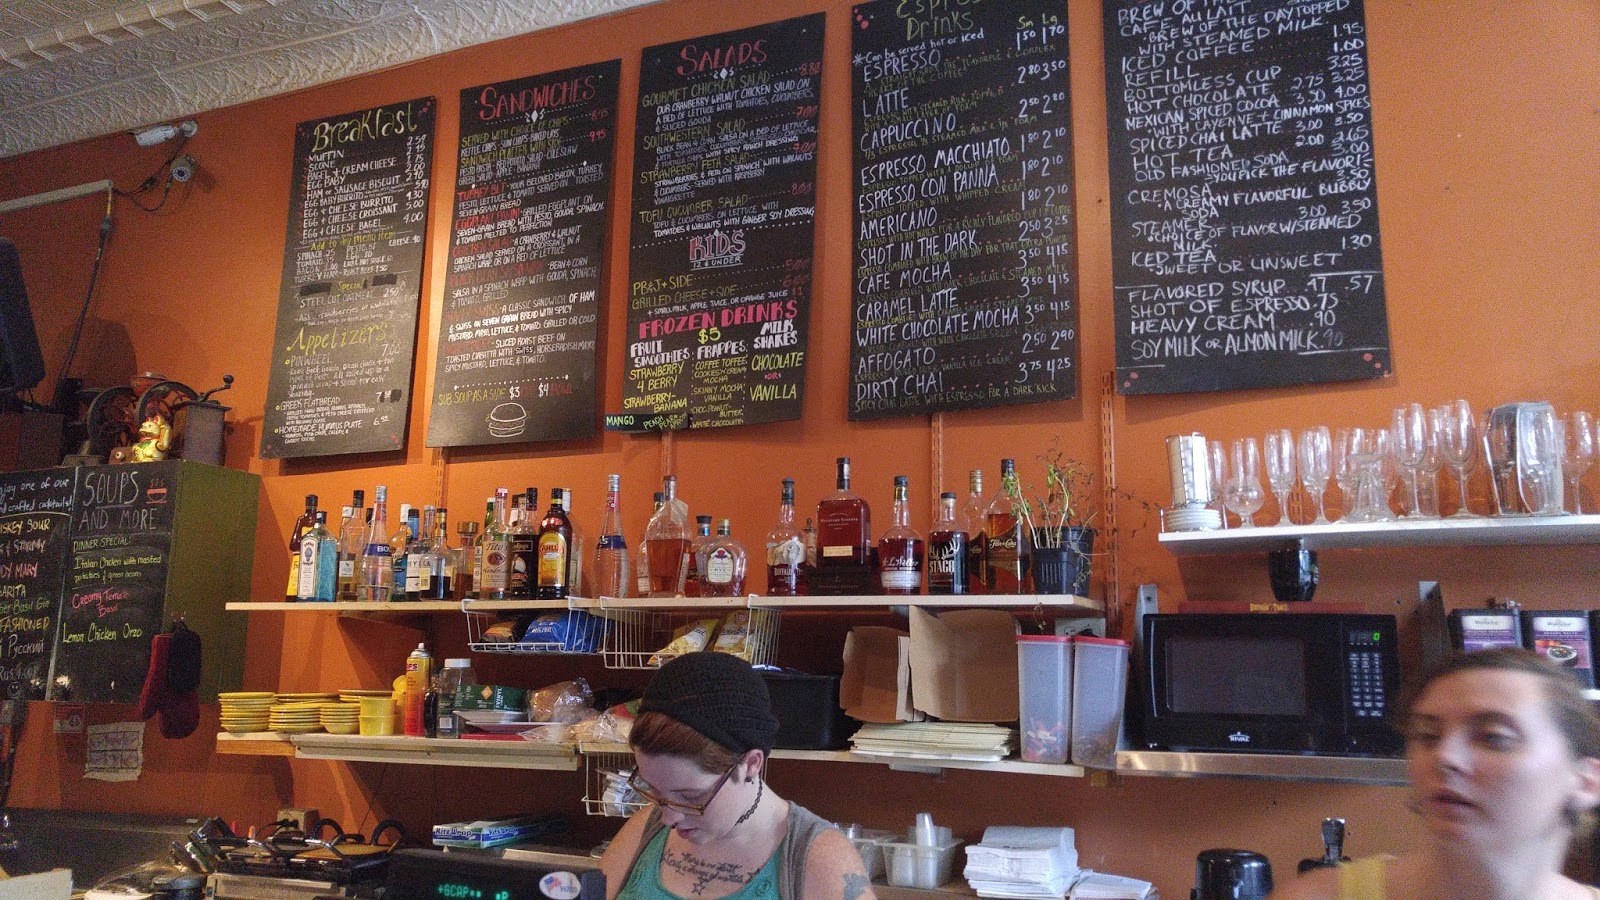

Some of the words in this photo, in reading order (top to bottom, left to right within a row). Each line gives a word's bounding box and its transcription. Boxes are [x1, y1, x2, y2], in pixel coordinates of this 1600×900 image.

[1118, 0, 1164, 25] BREW
[1121, 19, 1172, 36] CAFE
[1182, 11, 1201, 24] AU
[1206, 2, 1246, 20] LAIT
[907, 11, 974, 41] Drinks
[1149, 25, 1194, 43] BREW
[1200, 18, 1219, 32] OF
[1223, 11, 1257, 26] THE
[899, 41, 926, 55] served
[961, 27, 984, 42] iced
[1139, 39, 1175, 55] WITH
[1183, 27, 1269, 47] STEAMED
[676, 39, 768, 76] SALADS
[864, 49, 941, 83] ESPRESSO
[1122, 54, 1165, 73] ICED
[1176, 41, 1254, 62] COFFEE
[1124, 74, 1235, 102] BOTTOMLESS
[1246, 66, 1282, 82] CUP
[1125, 66, 1200, 87] REFILL
[480, 74, 596, 121] SANDWICHES
[642, 87, 688, 108] GOURMET
[691, 77, 736, 96] CHICKEN
[740, 71, 770, 86] SALAD
[1128, 98, 1167, 114] HOT
[1173, 84, 1271, 107] CHOCOLATE
[862, 88, 909, 119] LATTE
[1126, 110, 1184, 131] MEXICAN
[1189, 103, 1232, 119] SPICED
[1237, 98, 1279, 111] COCOA
[1274, 102, 1334, 120] CINNAMON
[312, 102, 418, 152] Breakfast
[716, 118, 746, 134] SALAD
[860, 112, 957, 152] CAPPUCCINO
[1129, 133, 1187, 155] SPICED
[1190, 126, 1226, 145] CHAI
[1233, 123, 1281, 140] LATTE
[308, 150, 344, 163] MUFFIN
[309, 161, 335, 172] SCONE
[702, 156, 721, 171] FETA
[725, 152, 750, 165] SALAD
[861, 155, 927, 187] ESPRESSO
[934, 137, 1010, 169] MACCHIATO
[1133, 153, 1179, 172] HOT
[1189, 145, 1233, 163] TEA
[1135, 169, 1165, 183] OLD
[1253, 150, 1289, 168] SODA
[307, 172, 330, 180] BAGEL
[342, 162, 369, 175] CREAM
[370, 157, 397, 170] CHEESE
[1274, 163, 1299, 177] THE
[306, 190, 323, 200] HAM
[334, 182, 366, 194] SAUSAGE
[369, 175, 400, 189] BISCUIT
[859, 183, 915, 214] ESPRESSO
[921, 176, 947, 198] CON
[953, 164, 999, 193] PANNA
[1128, 184, 1213, 205] CREMOSA
[1176, 193, 1229, 210] CREAMY
[1234, 187, 1312, 205] FLAVORFUL
[1319, 178, 1371, 196] BUBBLY
[303, 218, 318, 229] EGG
[358, 203, 399, 219] CROISSANT
[639, 208, 663, 224] TOFU
[718, 194, 748, 209] SALAD
[1182, 205, 1219, 221] SODA
[860, 206, 938, 241] AMERICANO
[1131, 218, 1213, 238] STEAMER
[1154, 228, 1203, 242] CHOICE
[1208, 226, 1226, 239] OF
[1232, 221, 1280, 237] FLAVOR
[689, 230, 746, 261] KIDS
[860, 244, 894, 269] SHOT
[900, 239, 914, 262] IN
[918, 235, 940, 256] THE
[944, 229, 978, 252] DARK
[711, 256, 742, 266] UNDER
[1131, 252, 1170, 267] ICED
[1173, 250, 1217, 263] TEA
[1156, 263, 1214, 275] SWEET
[1218, 259, 1245, 273] OR
[1251, 253, 1342, 271] UNSWEET
[669, 274, 694, 288] SIDE
[858, 273, 890, 295] CAFE
[900, 261, 953, 287] MOCHA
[569, 293, 578, 304] OF
[580, 291, 595, 302] HAM
[631, 293, 671, 310] GRILLED
[1128, 280, 1224, 303] FLAVORED
[1231, 279, 1286, 296] SYRUP
[482, 316, 500, 327] SEVEN
[555, 305, 572, 315] SPICY
[856, 295, 918, 323] CARAMEL
[921, 287, 959, 313] LATTE
[1130, 301, 1184, 319] SHOT
[1189, 300, 1222, 314] OF
[1231, 294, 1310, 313] ESPRESSO
[639, 311, 716, 340] FROZEN
[720, 299, 798, 328] DRINKS
[760, 319, 794, 335] MILK
[856, 324, 896, 347] WHITE
[902, 313, 969, 341] CHOCOLATE
[973, 305, 1019, 330] MOCHA
[1131, 315, 1197, 335] HEAVY
[1204, 312, 1275, 331] CREAM
[287, 323, 388, 356] Appetizers
[495, 338, 516, 349] SLICED
[538, 334, 555, 344] BEEF
[697, 327, 721, 344] $5
[753, 330, 798, 350] SHAKES
[1164, 334, 1208, 358] MILK
[1280, 330, 1318, 351] MILK
[630, 340, 663, 358] FRUIT
[634, 348, 691, 368] SMOOTHIES
[629, 362, 685, 380] STRAWBERRY
[695, 359, 719, 371] COFFEE
[751, 352, 804, 371] CHOCOLATE
[858, 347, 936, 375] AFFOGATO
[538, 383, 549, 398] $4
[637, 381, 644, 392] 4
[648, 375, 678, 390] BERRY
[703, 375, 729, 383] MOCHA
[856, 377, 898, 401] DIRTY
[904, 371, 944, 396] CHAI
[509, 385, 520, 400] $3
[749, 384, 797, 401] VANILLA
[654, 398, 688, 413] BANANA
[606, 415, 634, 426] MANGO
[21, 483, 35, 491] one
[41, 478, 50, 488] of
[54, 479, 69, 488] our
[82, 471, 139, 506] SOUPS
[8, 500, 35, 512] crafted
[27, 519, 50, 533] SOUR
[78, 509, 109, 531] AND
[119, 508, 158, 530] MORE
[73, 540, 98, 552] DINNER
[15, 562, 38, 577] MARY
[63, 623, 84, 643] Lemon
[88, 623, 117, 643] Chicken
[123, 623, 142, 638] Orzo
[451, 828, 472, 838] Wrap
